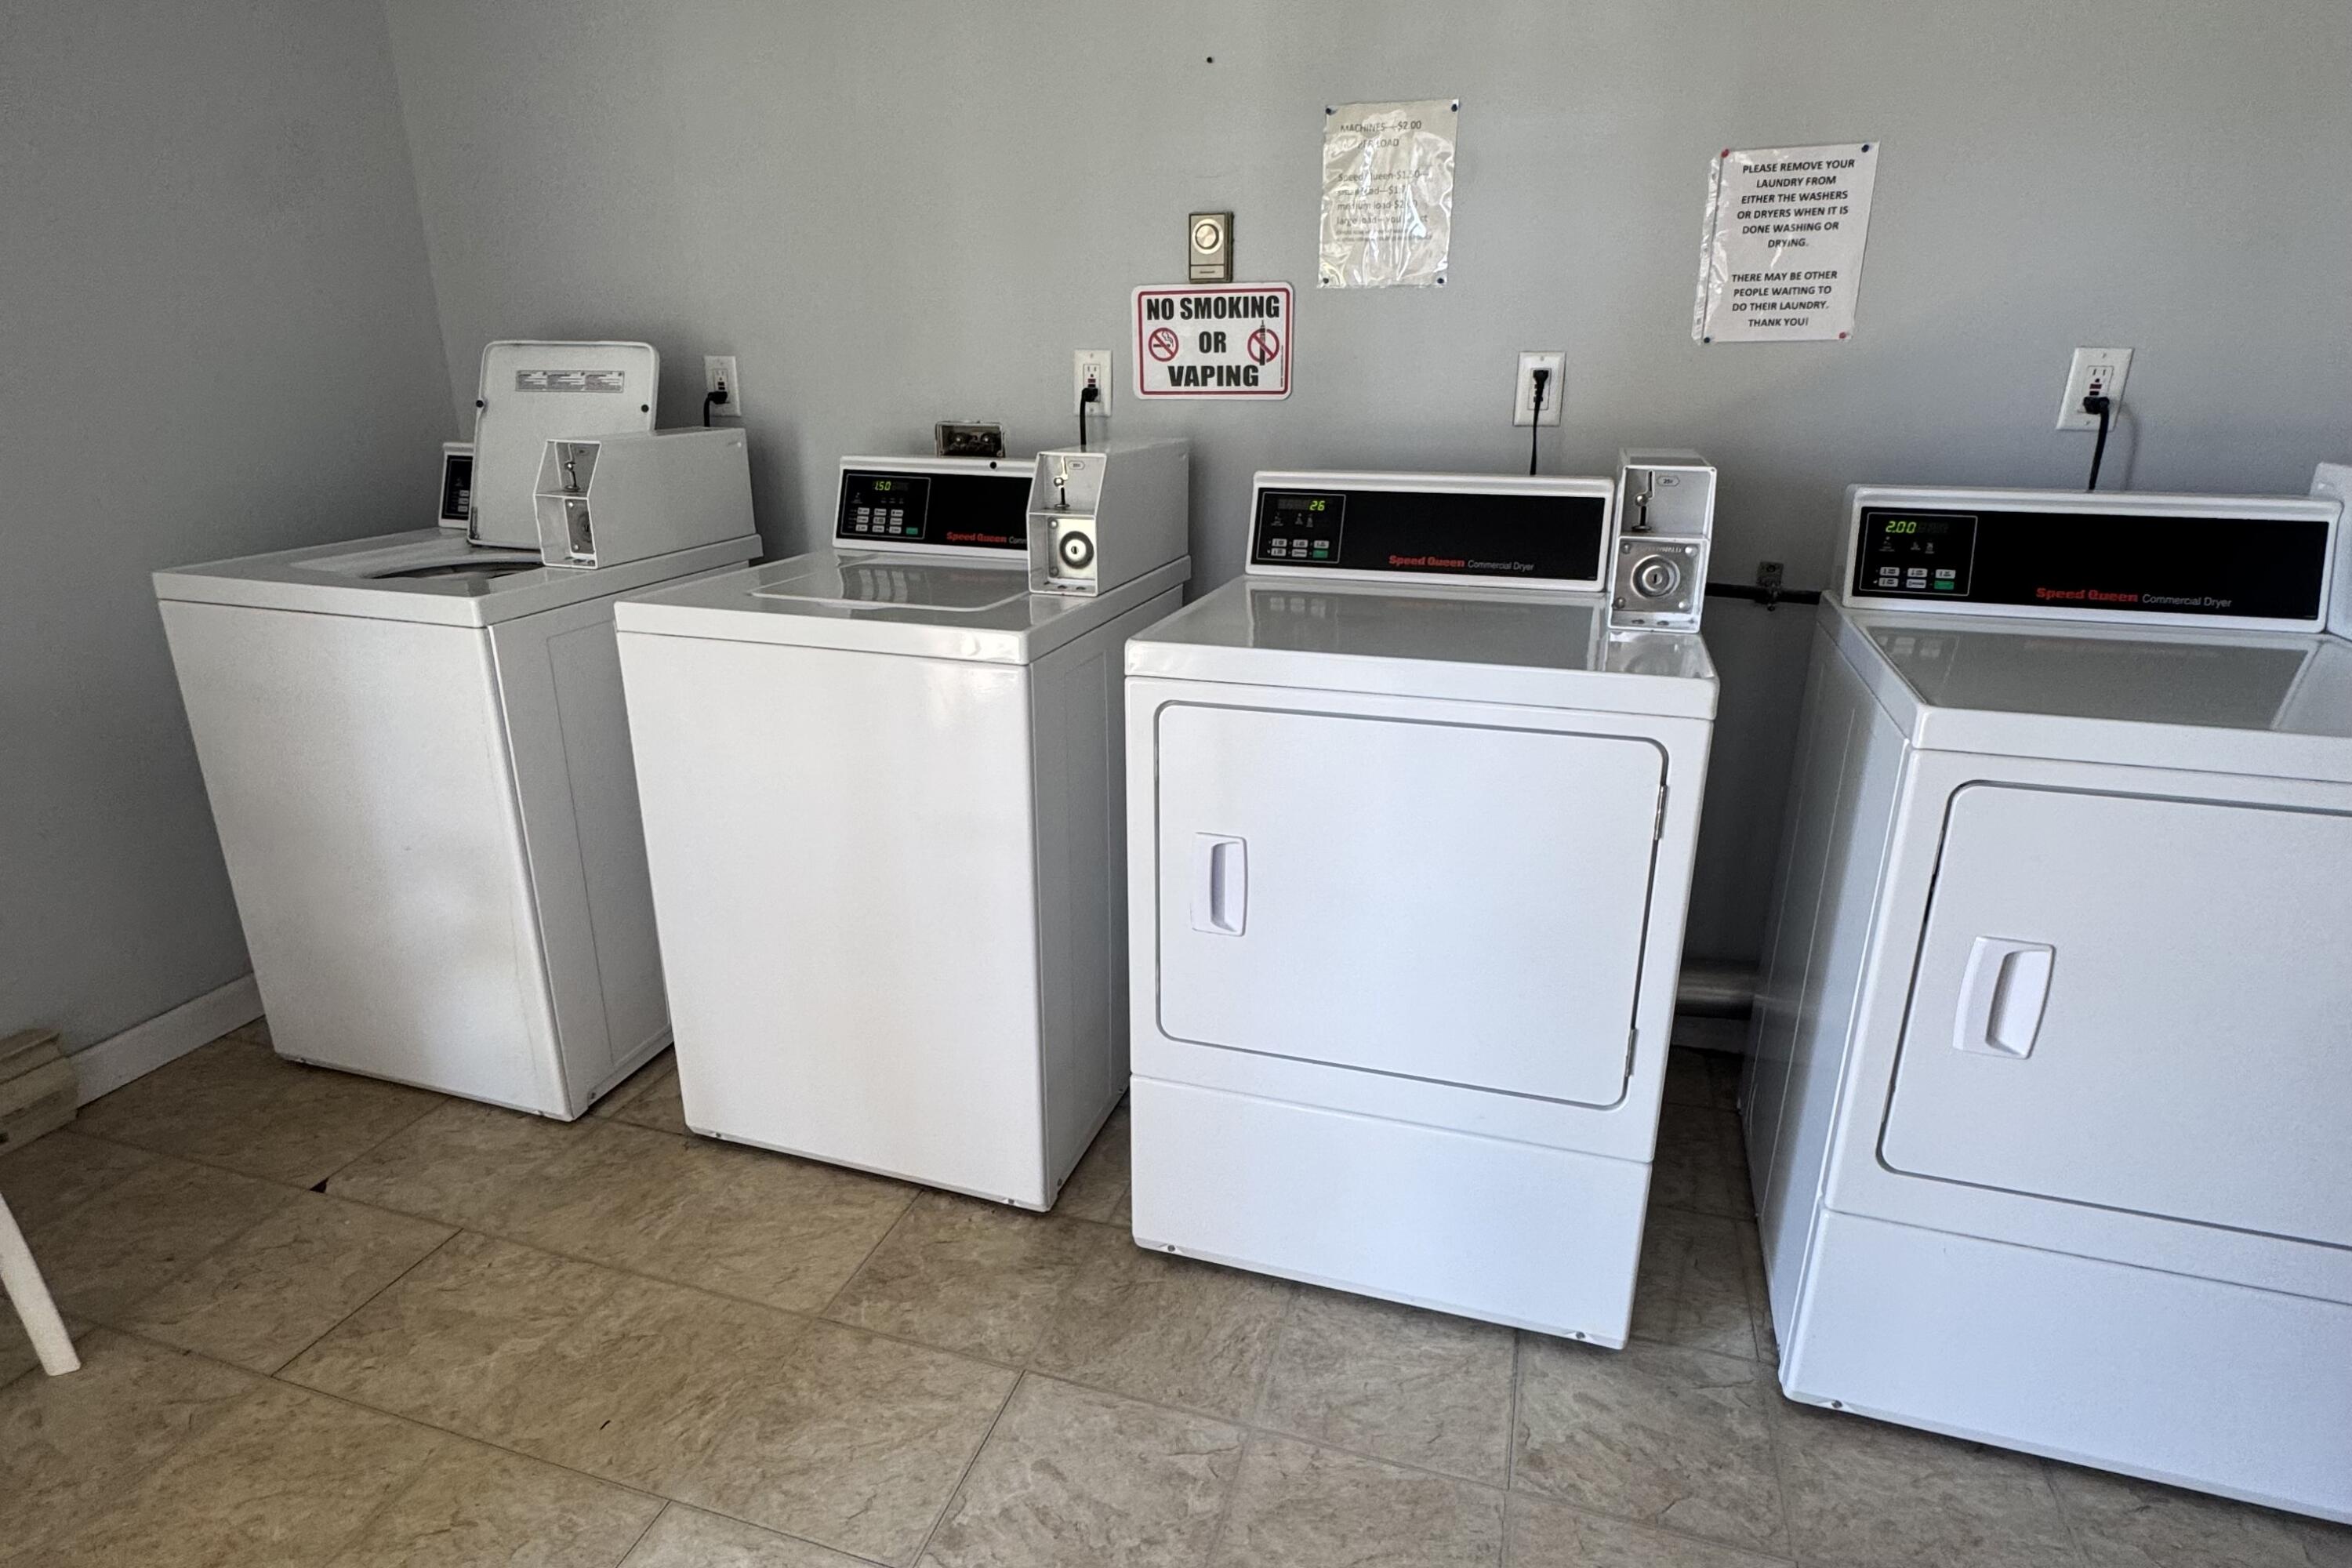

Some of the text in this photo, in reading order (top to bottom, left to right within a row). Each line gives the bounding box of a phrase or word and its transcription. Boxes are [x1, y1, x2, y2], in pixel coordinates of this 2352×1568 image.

[1376, 139, 1399, 148] LOAD
[1742, 159, 1855, 173] PLEASE REMOVE YOUR
[1756, 176, 1836, 188] LAUNDRY FROM
[1741, 191, 1848, 204] EITHER THE WASHERS
[1737, 205, 1849, 220] OR DRYERS WHEN IT IS
[1742, 221, 1839, 234] DONE WASHING OR
[1767, 238, 1809, 249] DRYING.
[1732, 270, 1838, 282] THERE MAY BE OTHER
[1733, 285, 1832, 297] PEOPLE WAITING TO
[1146, 295, 1280, 321] NO SMOKING
[1732, 300, 1829, 312] DO THEIR LAUNDRY.
[1748, 318, 1809, 327] THANK YOU!
[1199, 331, 1227, 354] OR
[1167, 365, 1260, 387] VAPING
[1309, 500, 1325, 511] 26
[1886, 521, 1917, 534] 2.00
[946, 532, 976, 542] Speed
[978, 533, 1007, 543] Queen
[1388, 555, 1534, 572] Speed Queen Commercial Dryer
[2036, 587, 2232, 608] Speed Queen Commercial Dryer
